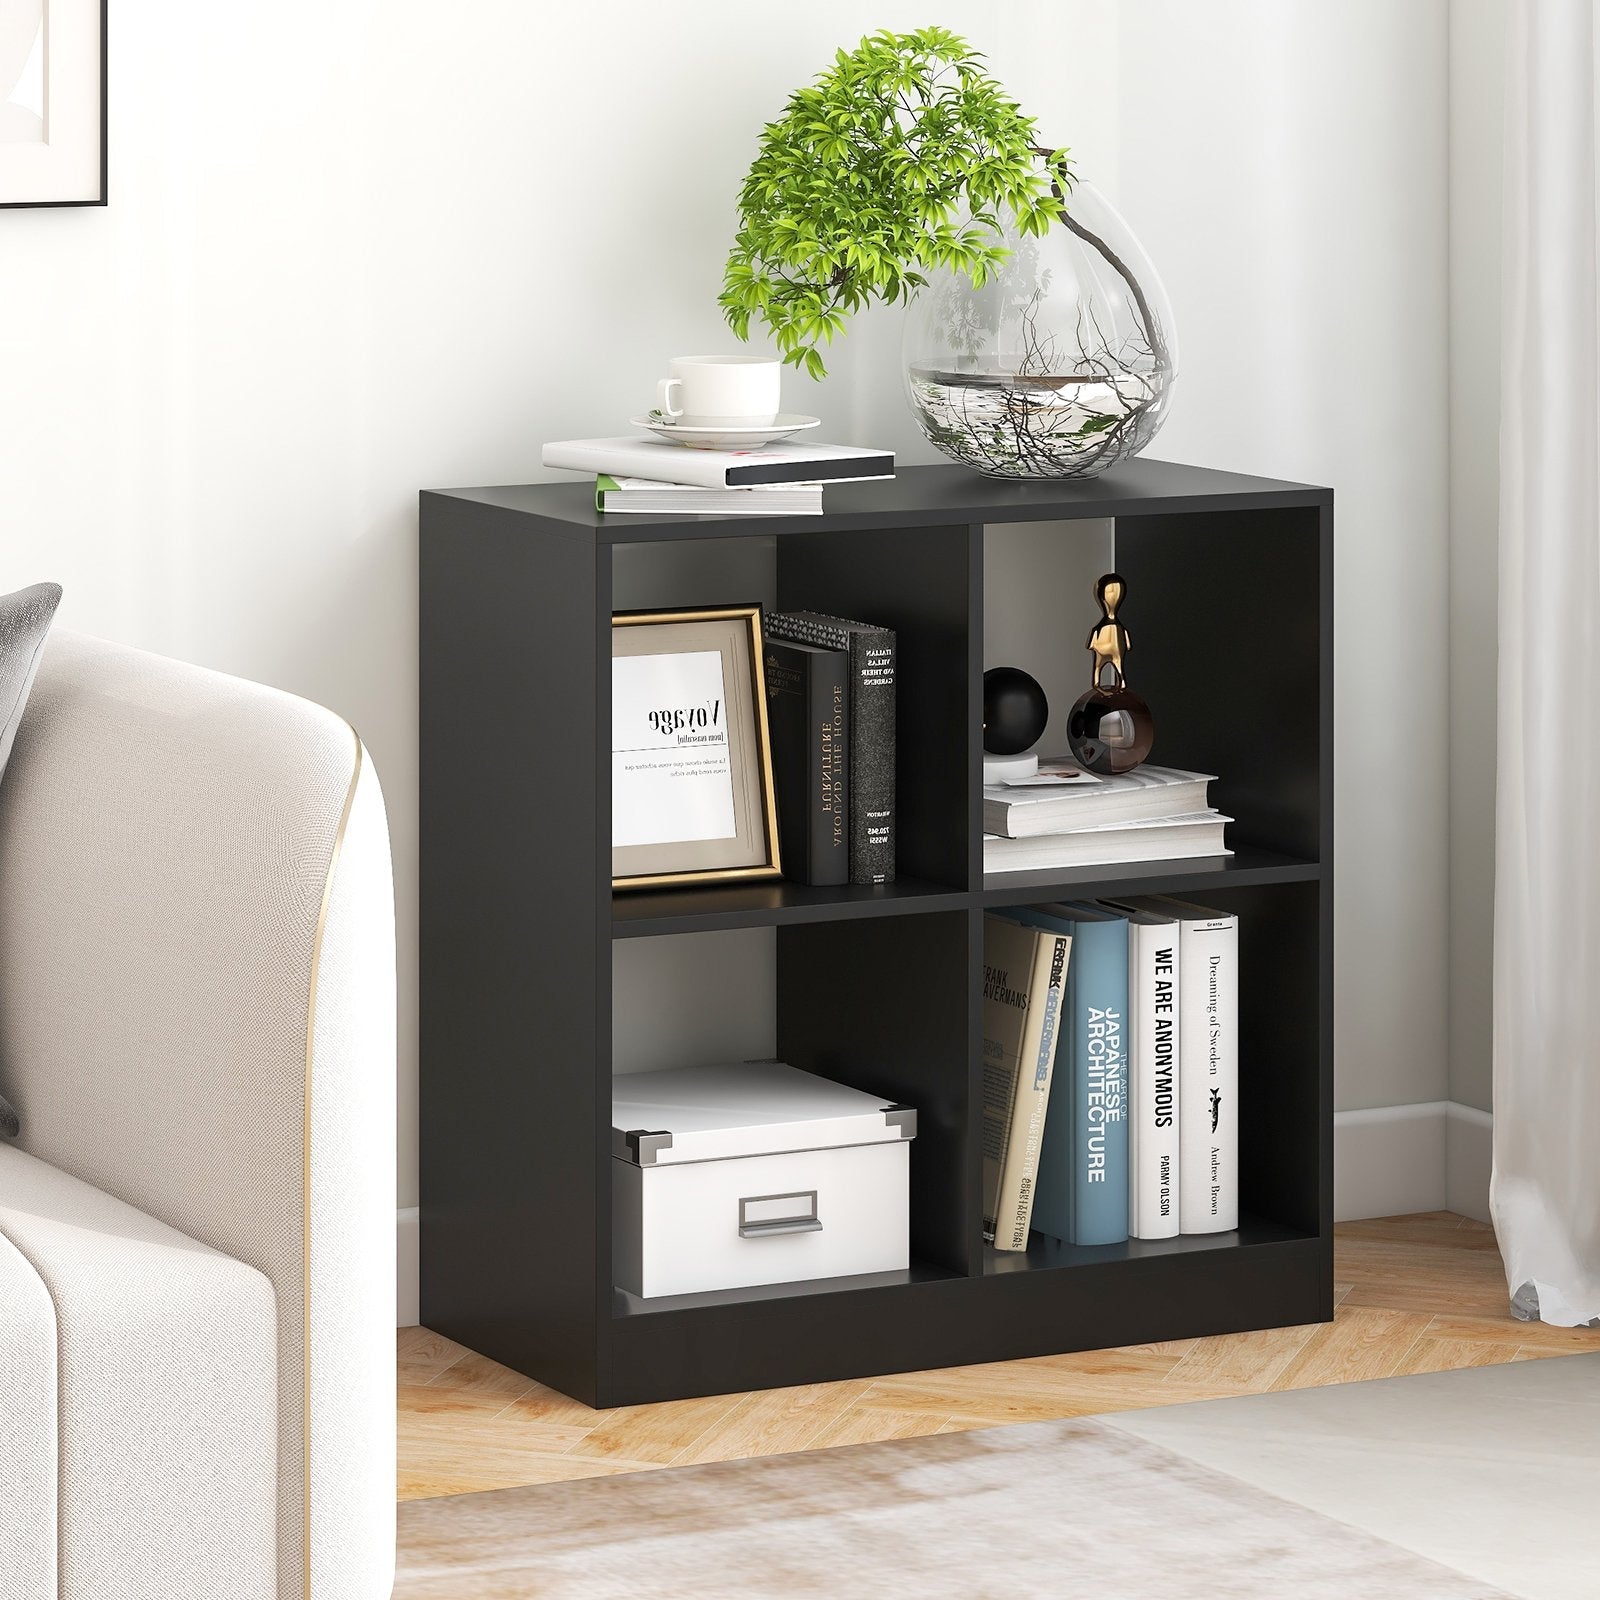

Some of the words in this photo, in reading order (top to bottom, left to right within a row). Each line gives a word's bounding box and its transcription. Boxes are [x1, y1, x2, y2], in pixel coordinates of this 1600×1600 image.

[1048, 936, 1067, 990] FRANK
[1155, 947, 1173, 976] WE
[1155, 980, 1173, 1014] ARE
[1206, 955, 1221, 1013] Dreaming
[1209, 1014, 1220, 1028] of
[1105, 1007, 1120, 1123] JAPANESE
[1120, 1052, 1128, 1074] THE
[1209, 1029, 1221, 1075] Sweden
[1120, 1078, 1128, 1099] ART
[1155, 1019, 1173, 1128] ANONYMOUS
[1088, 1007, 1105, 1183] ARCHITECTURE
[1120, 1104, 1128, 1120] OF
[1160, 1155, 1170, 1186] PARMY
[1210, 1146, 1221, 1182] Andrew
[1160, 1188, 1170, 1217] OLSON
[1210, 1185, 1221, 1215] Brown
